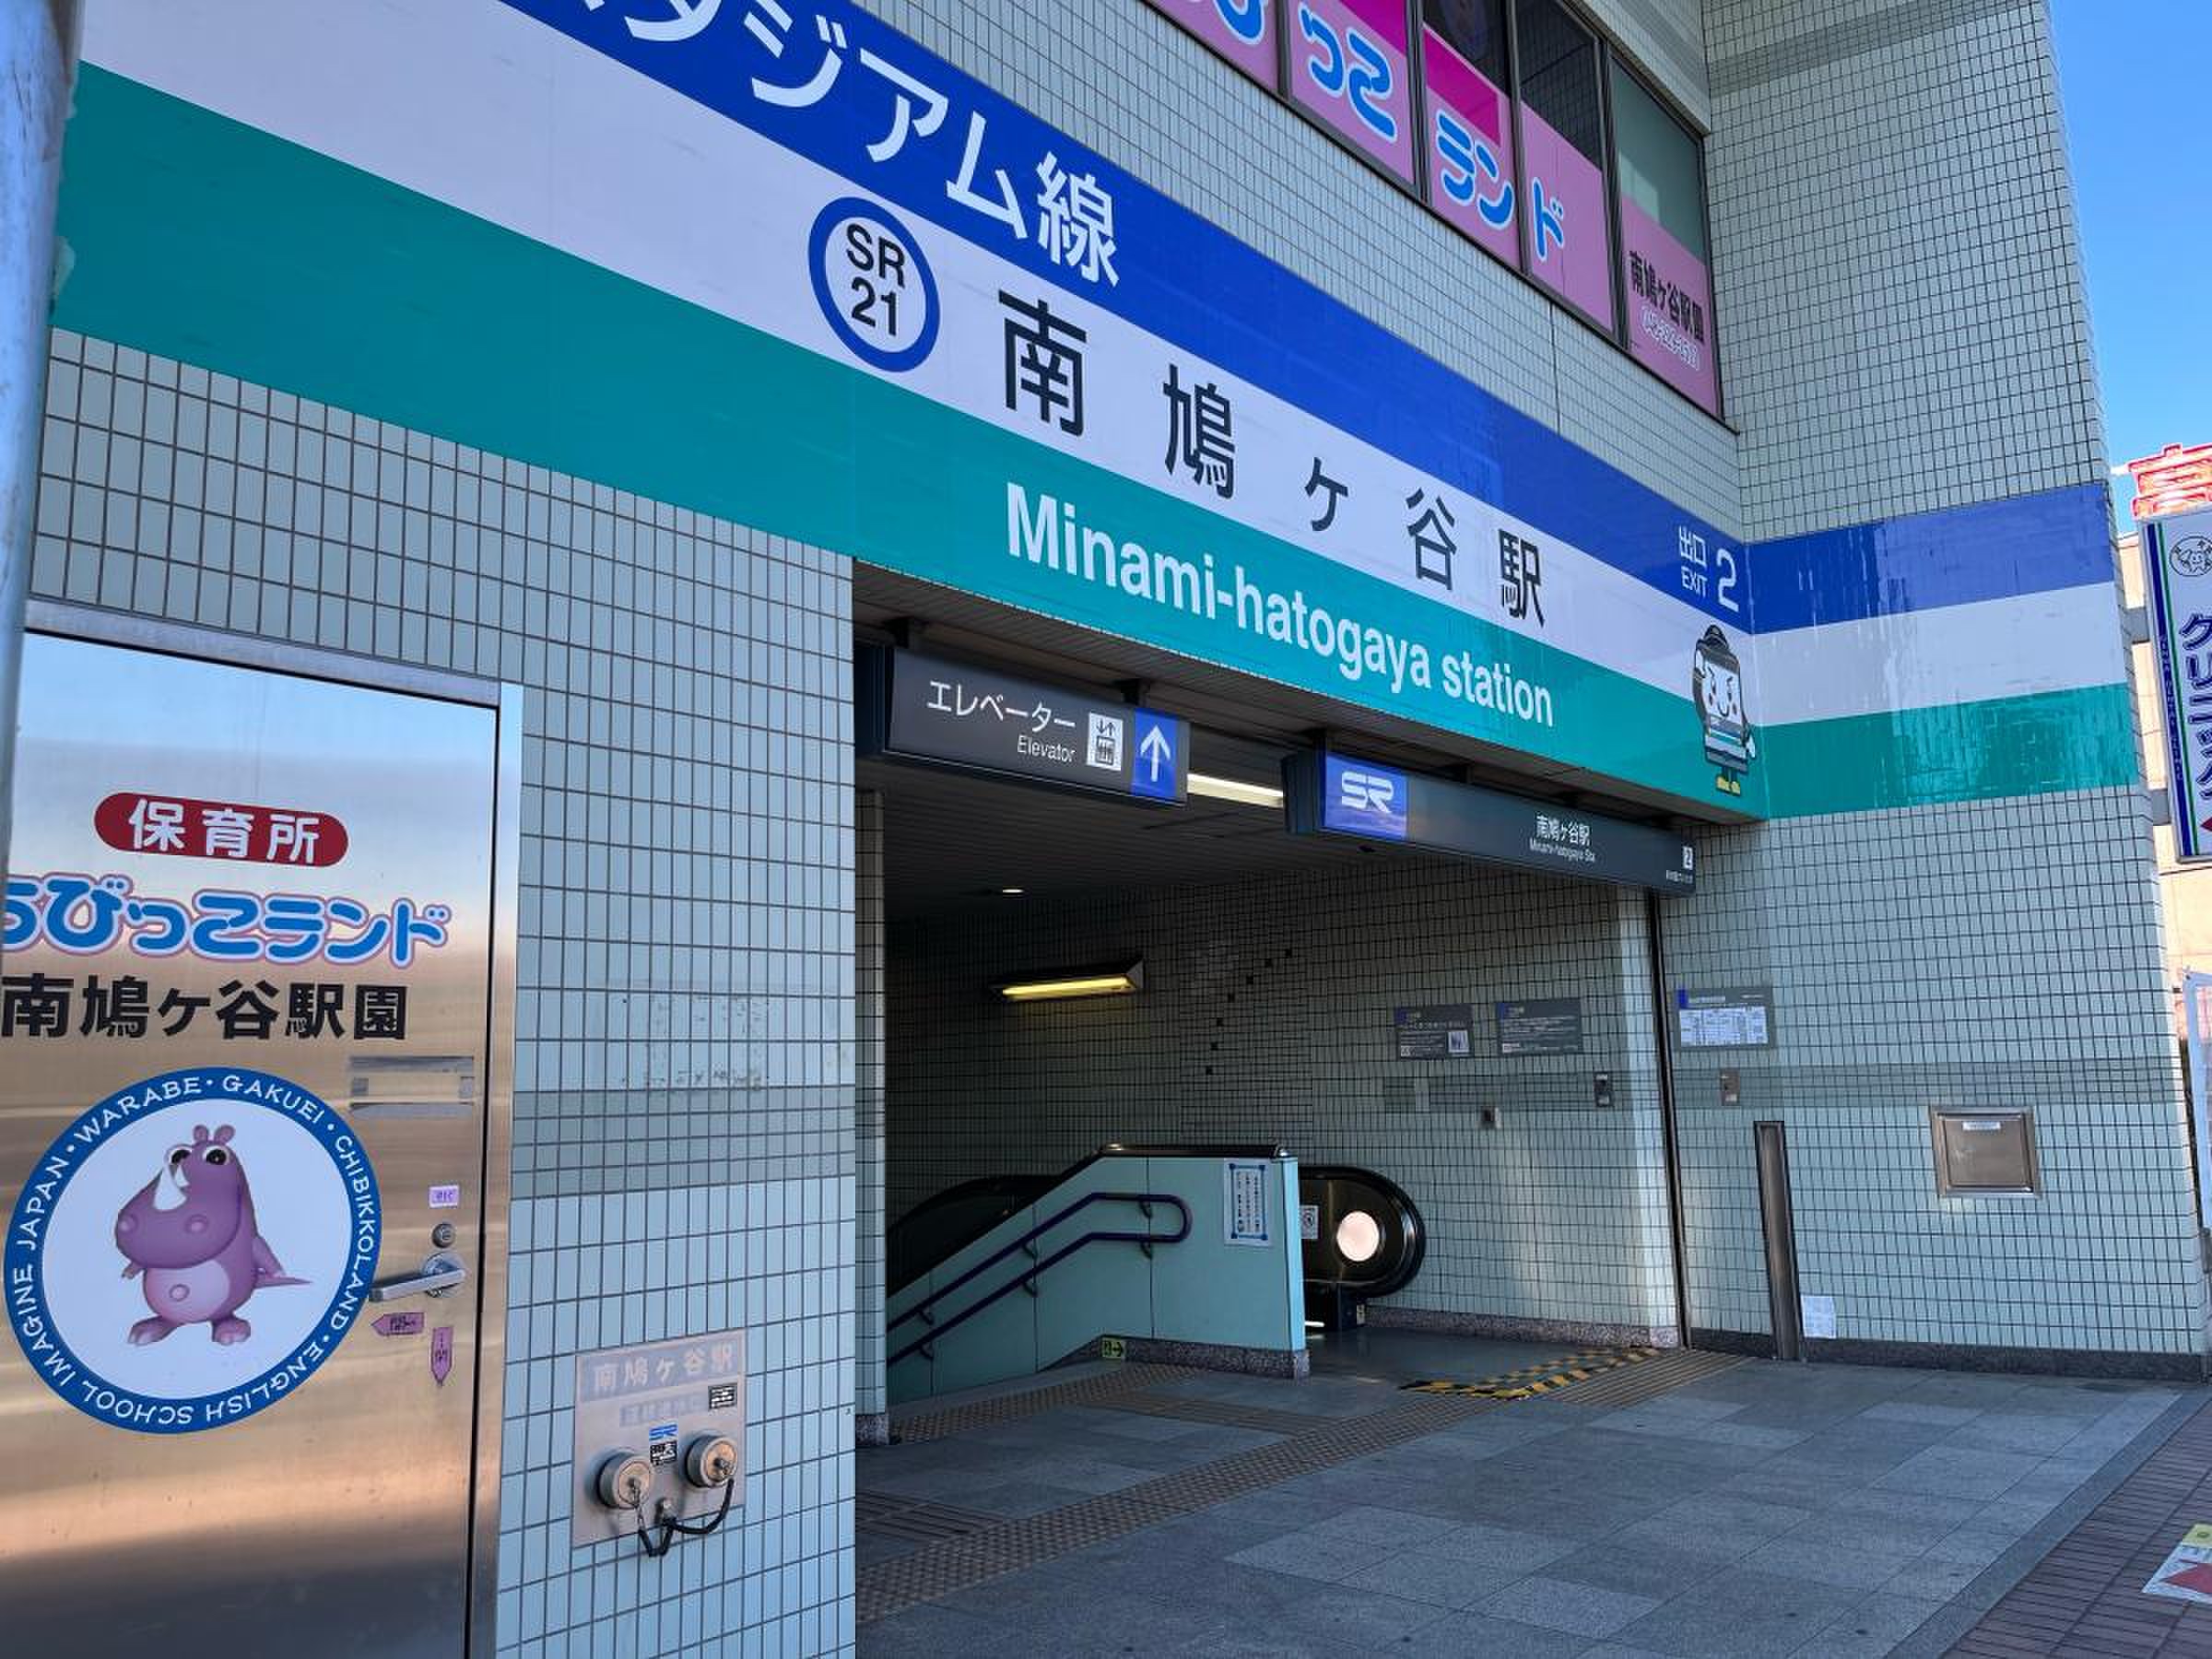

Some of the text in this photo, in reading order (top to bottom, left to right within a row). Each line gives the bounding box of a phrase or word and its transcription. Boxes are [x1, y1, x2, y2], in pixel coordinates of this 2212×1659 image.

[584, 0, 1119, 286] ジアム線
[845, 223, 906, 288] SR
[851, 277, 898, 335] 21
[1678, 524, 1707, 568] 出口
[1006, 482, 1553, 727] Minami-hatogaya station
[1681, 565, 1707, 597] EXIT
[1716, 547, 1739, 613] 2
[927, 680, 1077, 733] エレベーター
[1017, 735, 1077, 763] Elevator
[1341, 771, 1392, 815] SR
[128, 798, 321, 865] 保育所
[13, 1075, 375, 1424] WARABE GAKUEI CHIBIKKOLAND ENGLISH SCHOOL IMAGINE JAPAN
